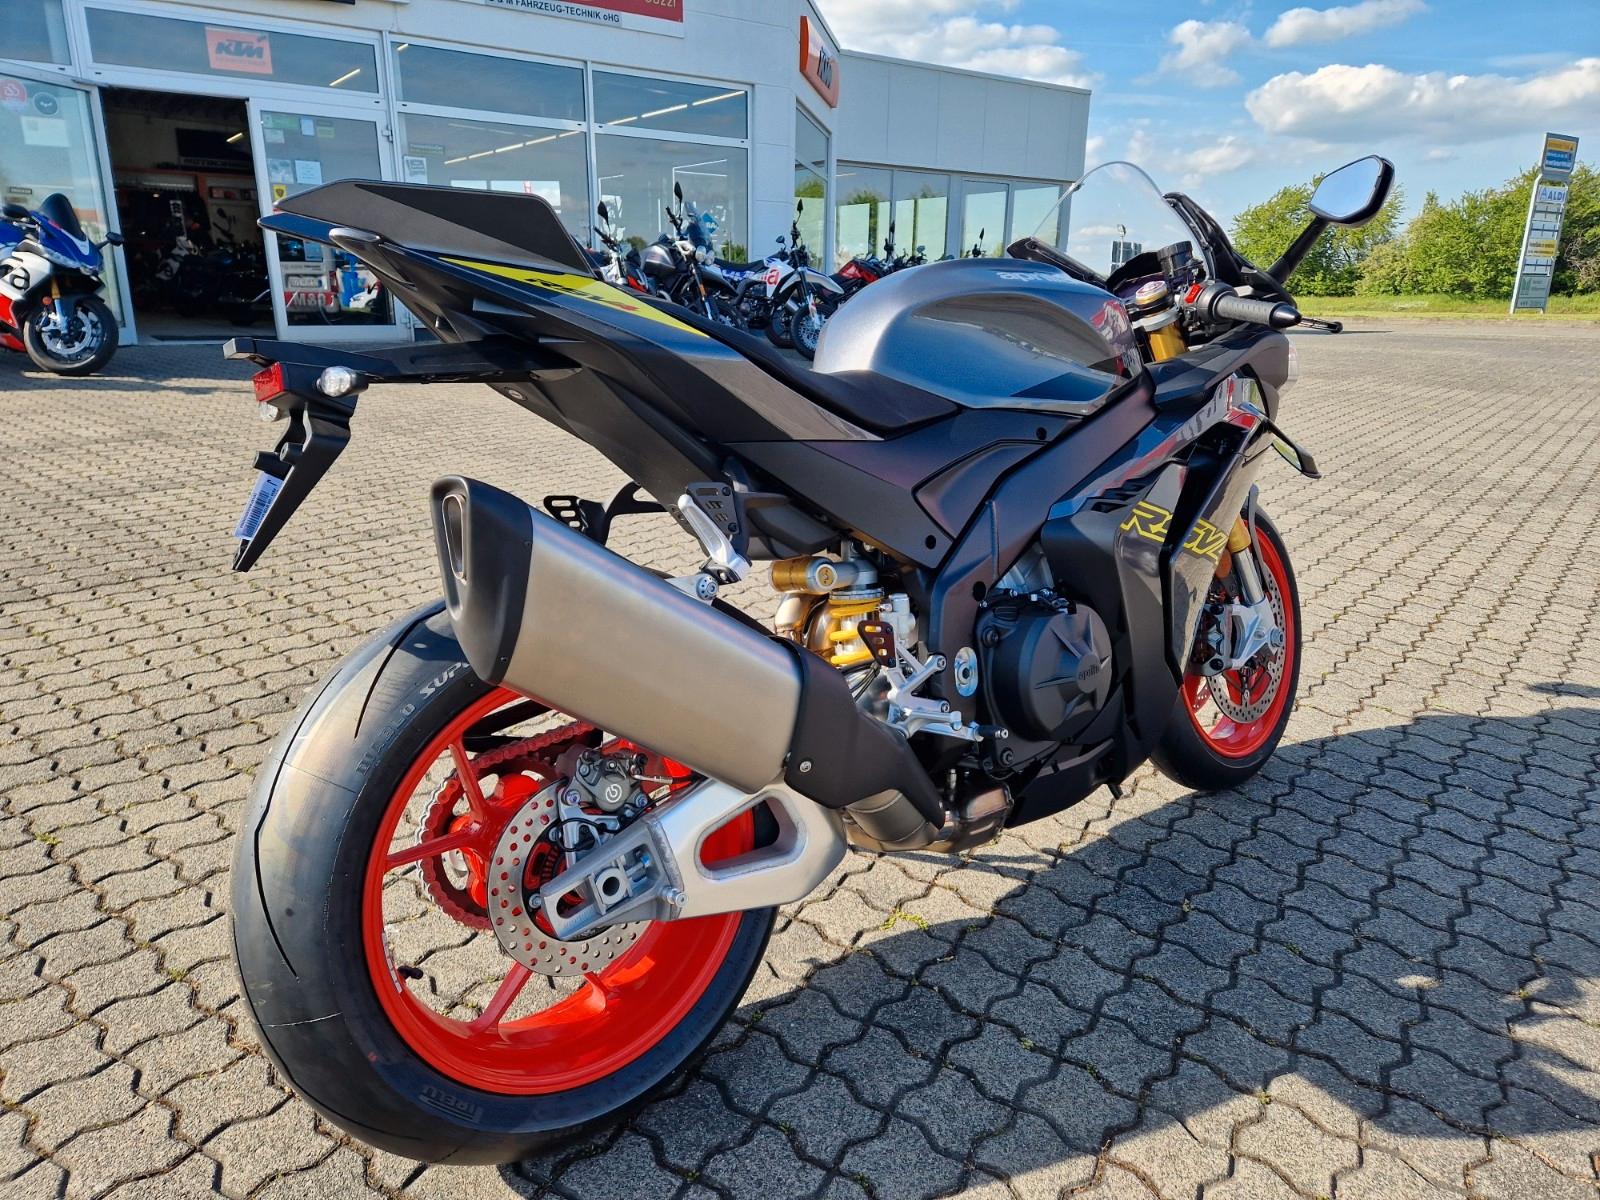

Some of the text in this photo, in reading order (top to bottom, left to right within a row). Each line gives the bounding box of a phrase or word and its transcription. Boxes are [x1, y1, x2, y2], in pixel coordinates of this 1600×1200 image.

[603, 14, 620, 23] oHG
[1548, 190, 1565, 202] ALDI
[419, 661, 471, 699] SUP
